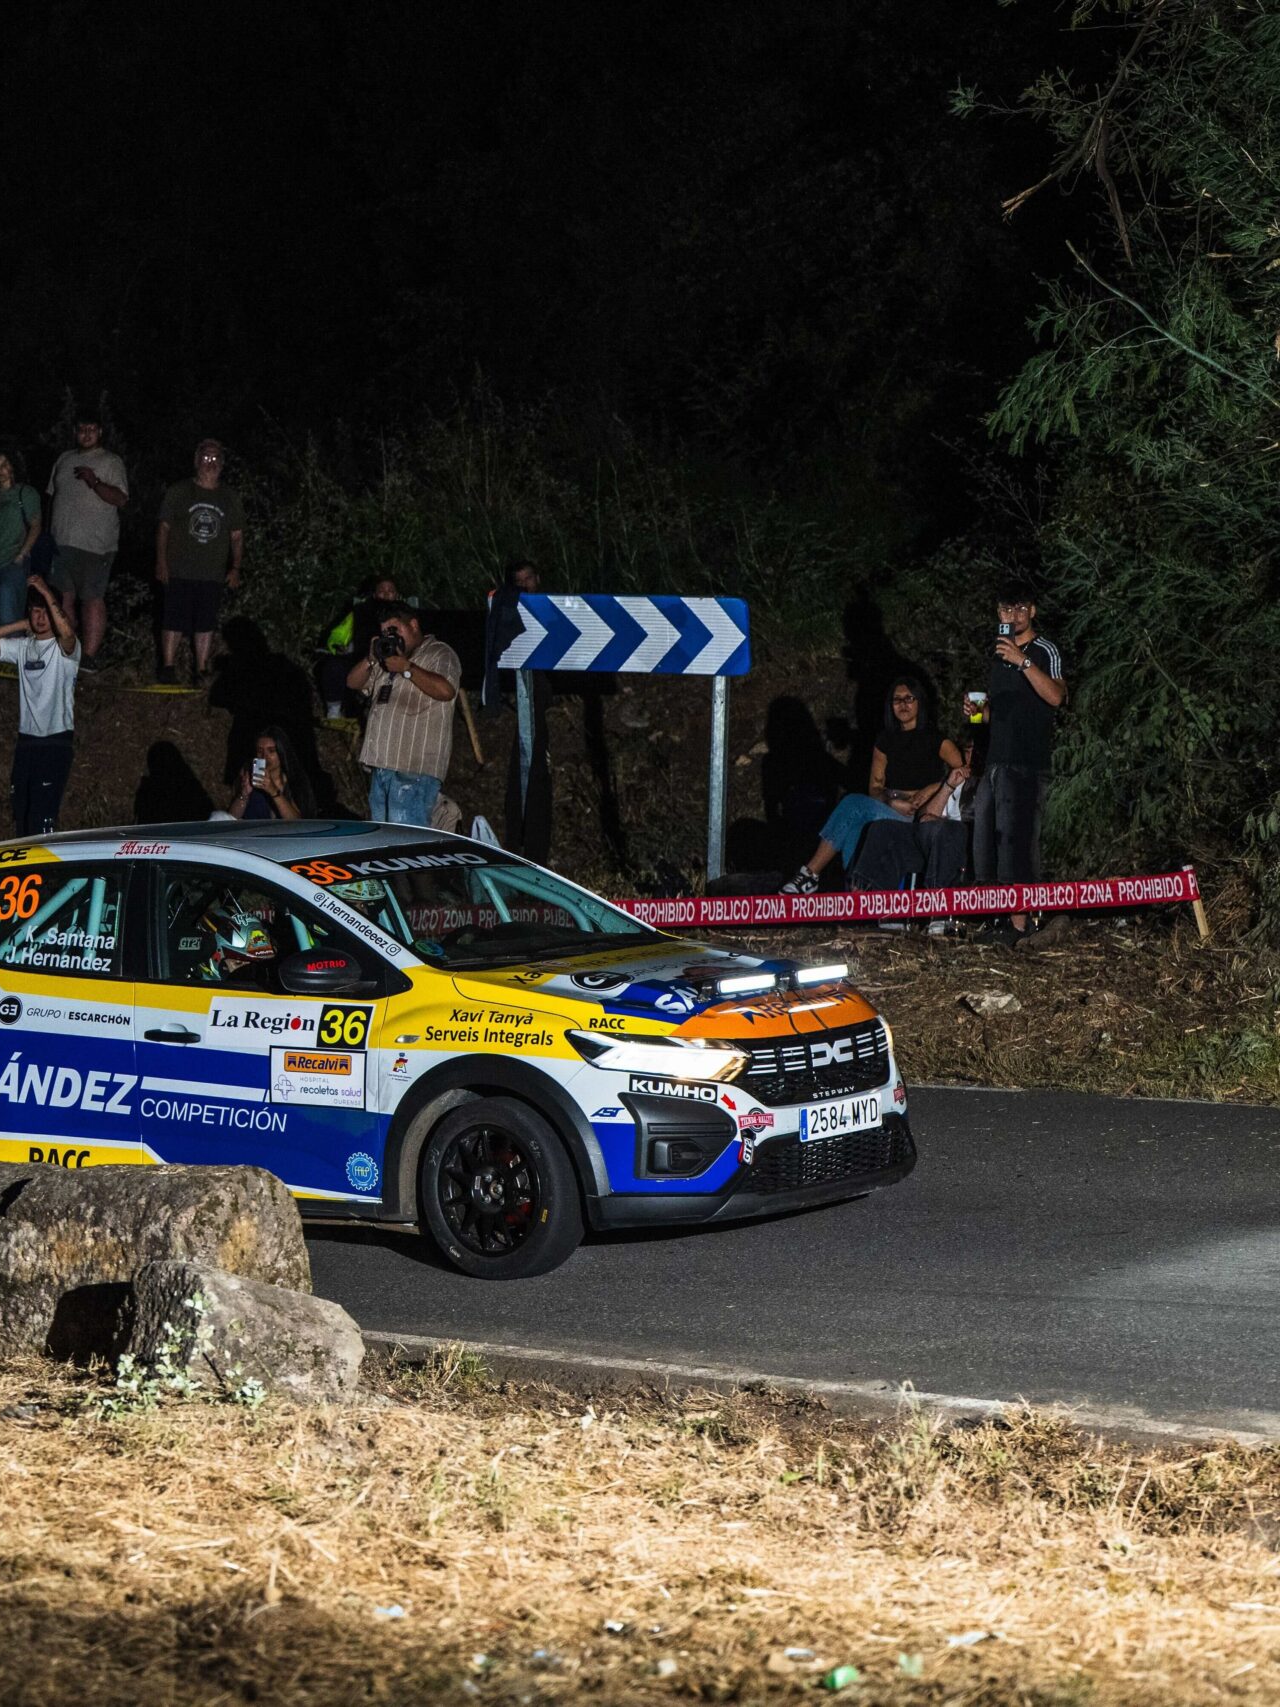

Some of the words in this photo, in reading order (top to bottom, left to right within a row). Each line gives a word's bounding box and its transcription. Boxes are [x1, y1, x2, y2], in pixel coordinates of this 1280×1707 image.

[289, 860, 353, 885] 36
[346, 853, 488, 875] KUMHO
[634, 902, 695, 924] PROHIBIDO
[700, 900, 749, 922] PUBLICO
[754, 899, 786, 920] ZONA
[791, 895, 854, 919] PROHIBIDO
[859, 892, 910, 914] PUBLICO
[915, 890, 947, 913] ZONA
[953, 887, 1017, 911] PROHIBIDO
[1022, 884, 1074, 907] PUBLICO
[1079, 882, 1113, 904] ZONA
[1118, 875, 1184, 902] PROHIBIDO
[313, 892, 388, 949] @j.hernandeeez
[307, 960, 347, 972] MOTRIO
[26, 1007, 62, 1019] GRUPO
[68, 1011, 131, 1026] ESCARCHÓN
[211, 1009, 239, 1028] La
[449, 1009, 484, 1023] Xavi
[589, 1018, 626, 1030] RACC
[320, 1009, 367, 1046] 36
[425, 1026, 479, 1043] Serveis
[484, 1027, 554, 1048] Integrals
[297, 1056, 339, 1071] Recalvi
[299, 1086, 339, 1096] recoletas
[341, 1087, 362, 1097] salud
[631, 1079, 717, 1101] KUMHO
[812, 1085, 855, 1099] STEPWAY
[140, 1097, 288, 1133] COMPETICIÓN
[810, 1104, 848, 1135] 2584
[851, 1098, 878, 1126] MYD
